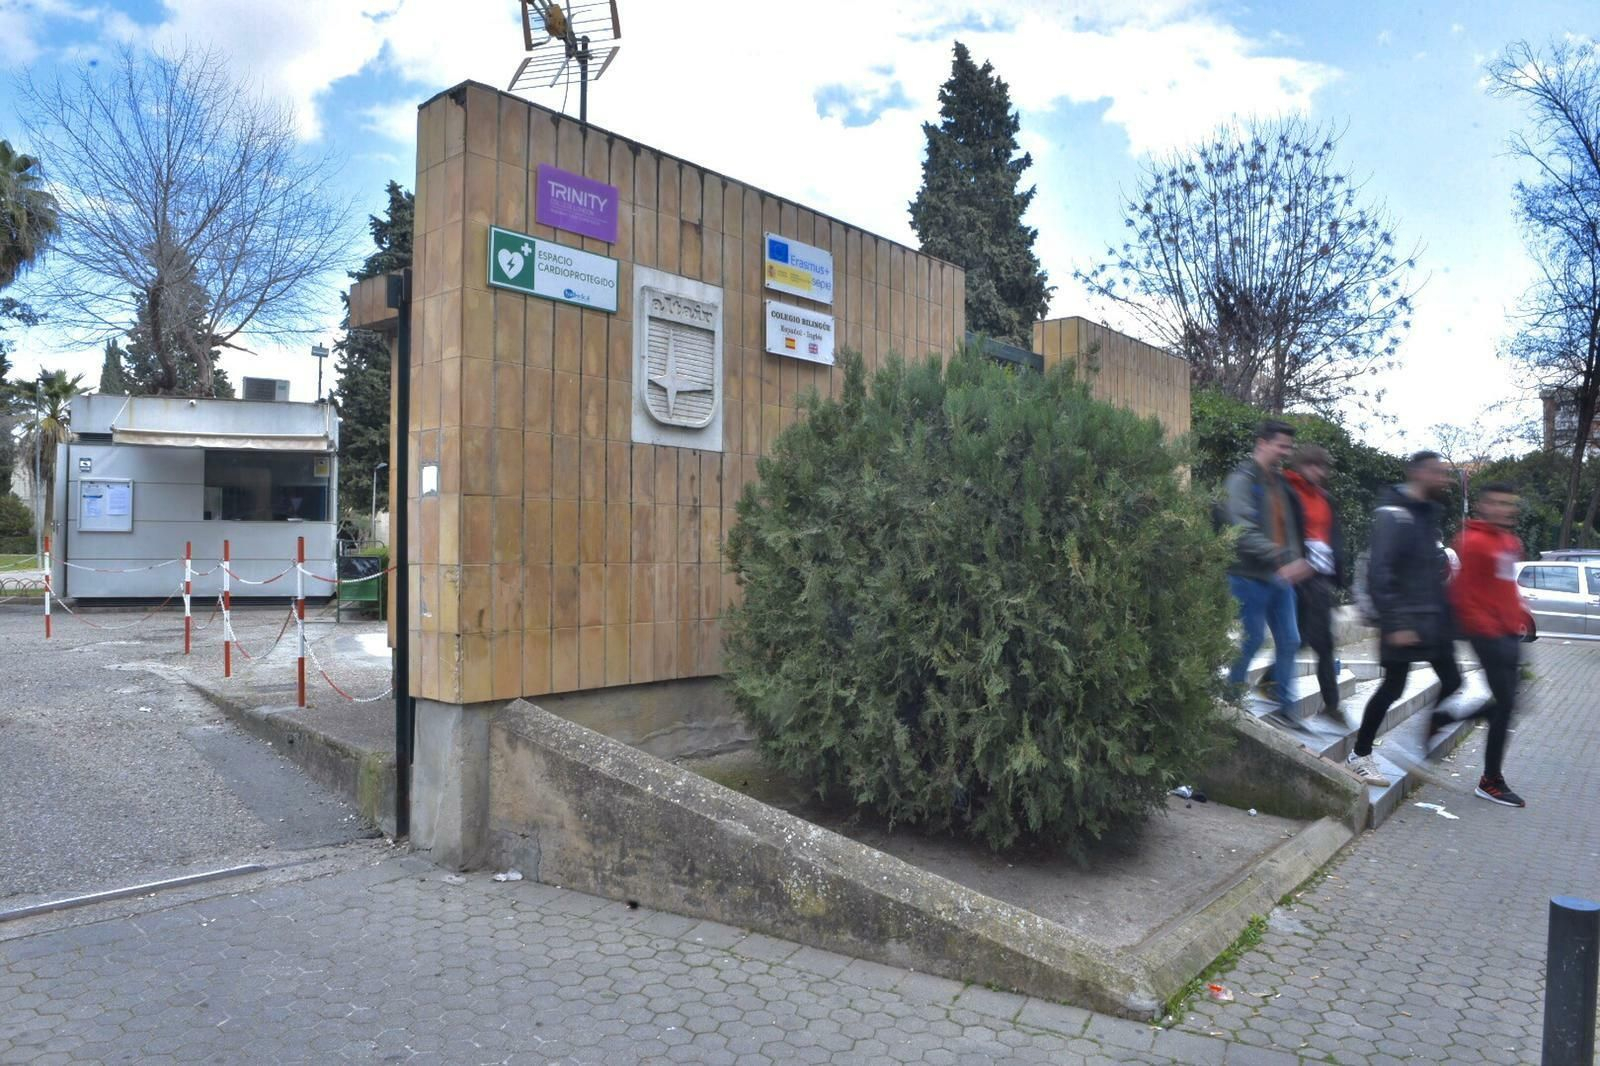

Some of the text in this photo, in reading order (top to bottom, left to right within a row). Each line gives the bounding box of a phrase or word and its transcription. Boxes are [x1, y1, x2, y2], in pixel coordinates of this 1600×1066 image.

[547, 180, 608, 212] TRINITY
[538, 250, 573, 266] ESPACIO
[790, 255, 830, 275] Erasmus+
[538, 263, 615, 288] CARDIOPROTEGIDO
[771, 310, 800, 325] COLEGIO
